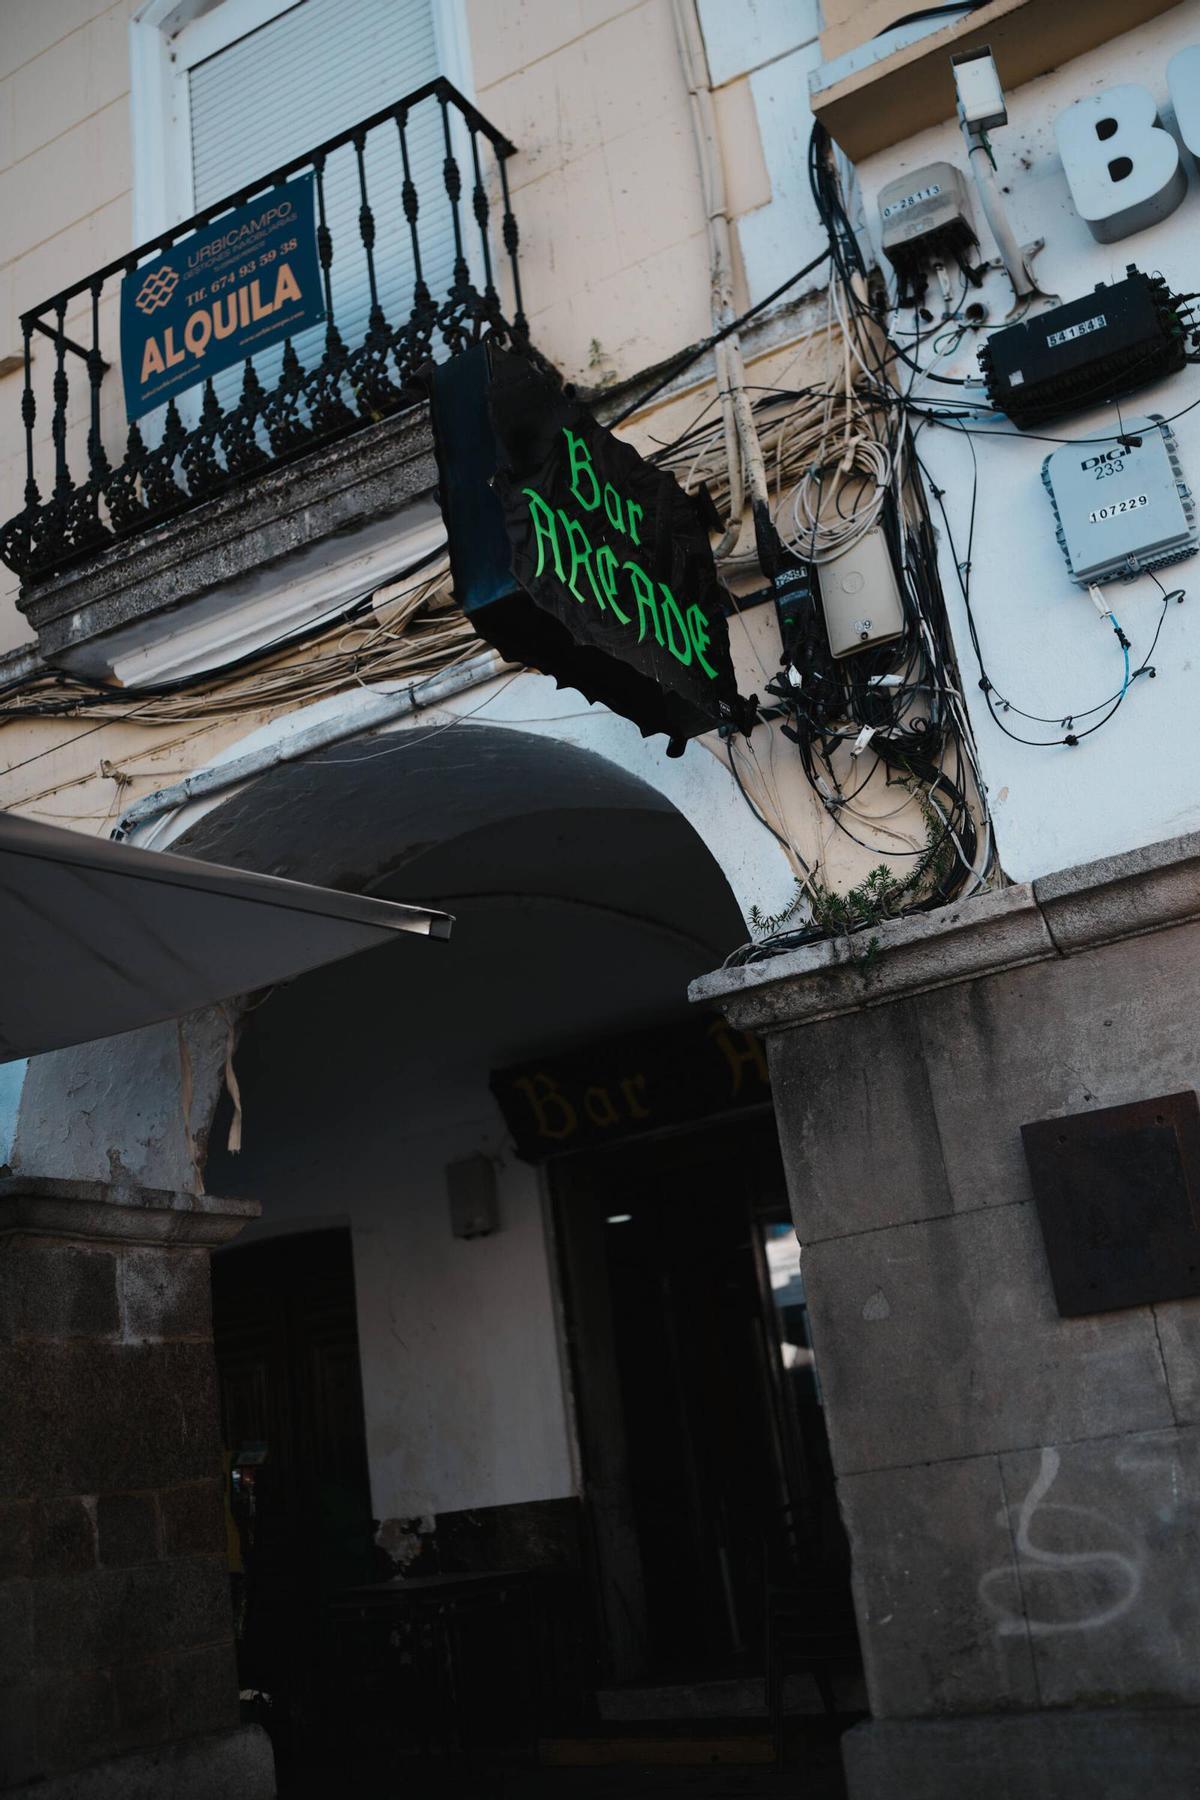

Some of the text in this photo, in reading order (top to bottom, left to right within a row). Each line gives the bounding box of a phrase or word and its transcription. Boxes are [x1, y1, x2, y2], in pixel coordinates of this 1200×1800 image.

[187, 202, 292, 268] URBICAMPO
[211, 271, 235, 294] 674
[239, 260, 257, 278] 93
[259, 250, 277, 266] 59
[280, 238, 298, 256] 38
[140, 263, 302, 384] ALQUILA
[1048, 315, 1106, 347] 541543
[562, 426, 644, 546] Bar
[1080, 445, 1132, 472] DIGI
[1094, 459, 1125, 480] 233
[1090, 495, 1148, 524] 107229
[513, 1072, 652, 1139] Bar
